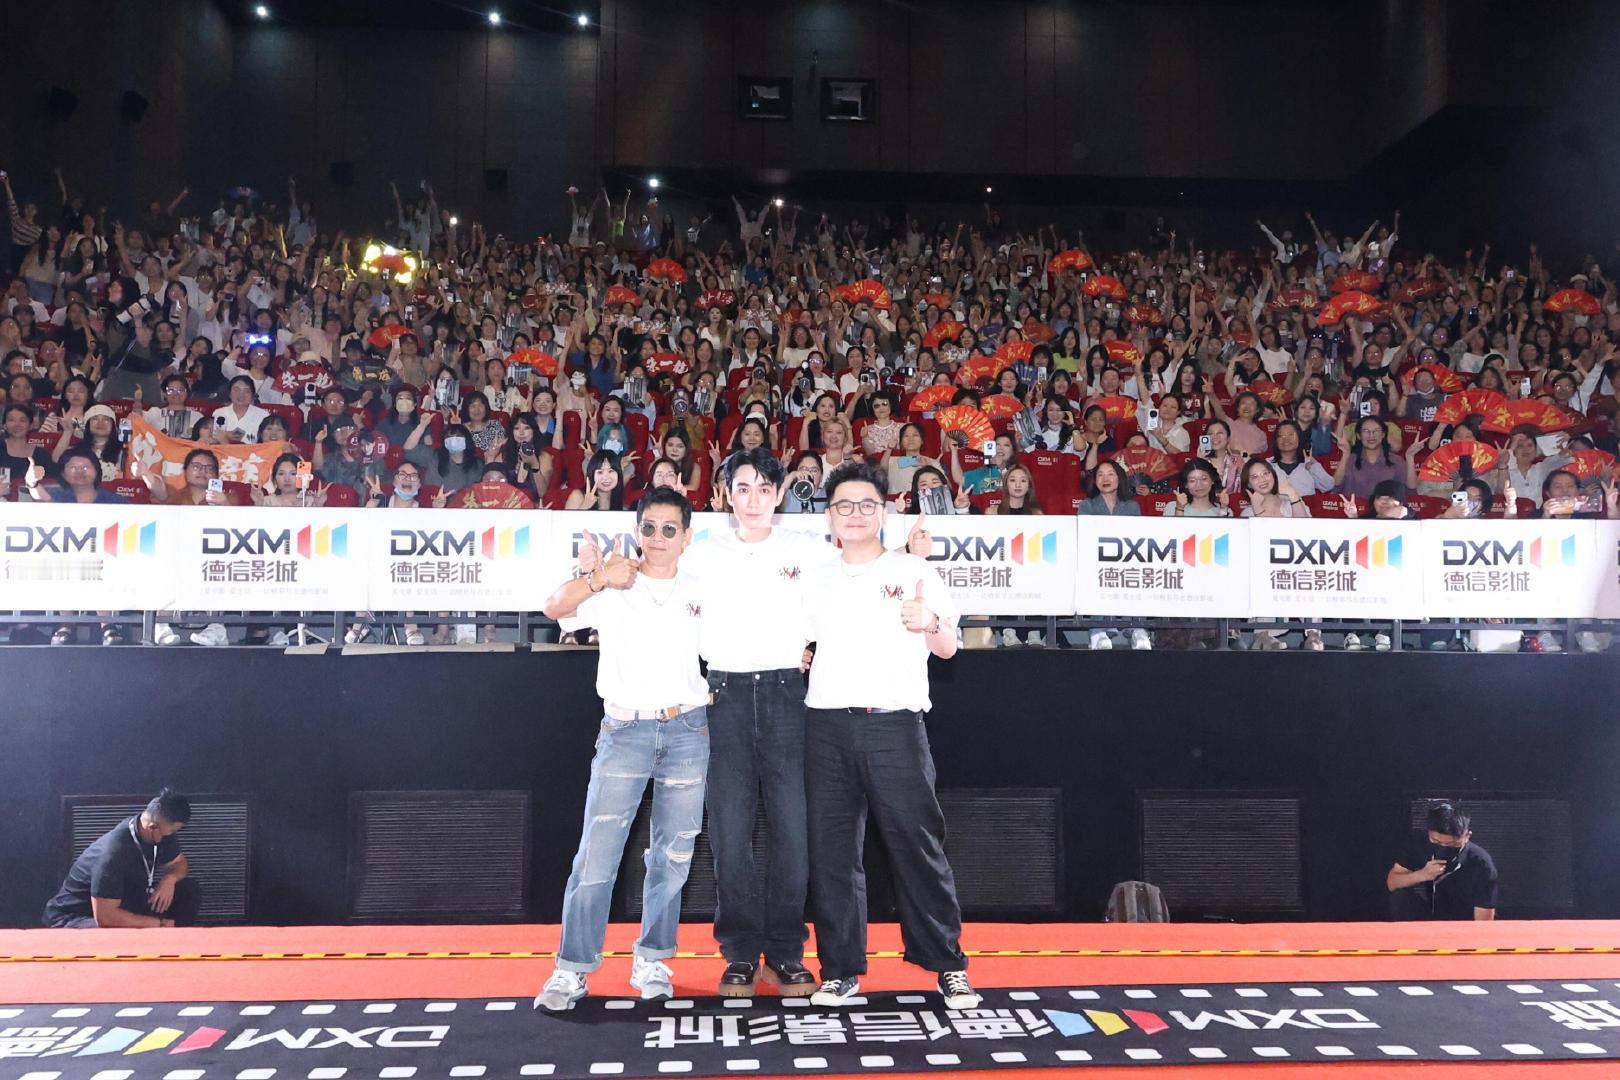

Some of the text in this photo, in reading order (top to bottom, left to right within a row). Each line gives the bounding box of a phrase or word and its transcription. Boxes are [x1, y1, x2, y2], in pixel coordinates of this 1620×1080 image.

[5, 526, 97, 553] DXM
[201, 527, 291, 555] DXM
[390, 529, 476, 557] DXM
[925, 536, 1005, 562] DXM
[1097, 536, 1177, 564] DXM
[1269, 538, 1350, 566] DXM
[1442, 540, 1524, 566] DXM
[201, 559, 298, 583] 德信影城
[389, 560, 483, 584] 德信影城
[1097, 567, 1184, 590] 德信影城
[1269, 568, 1358, 592] 德信影城
[1443, 570, 1531, 592] 德信影城
[643, 1008, 1054, 1049] 德信影城
[1168, 1008, 1381, 1030] DXM
[224, 1025, 451, 1051] DXM
